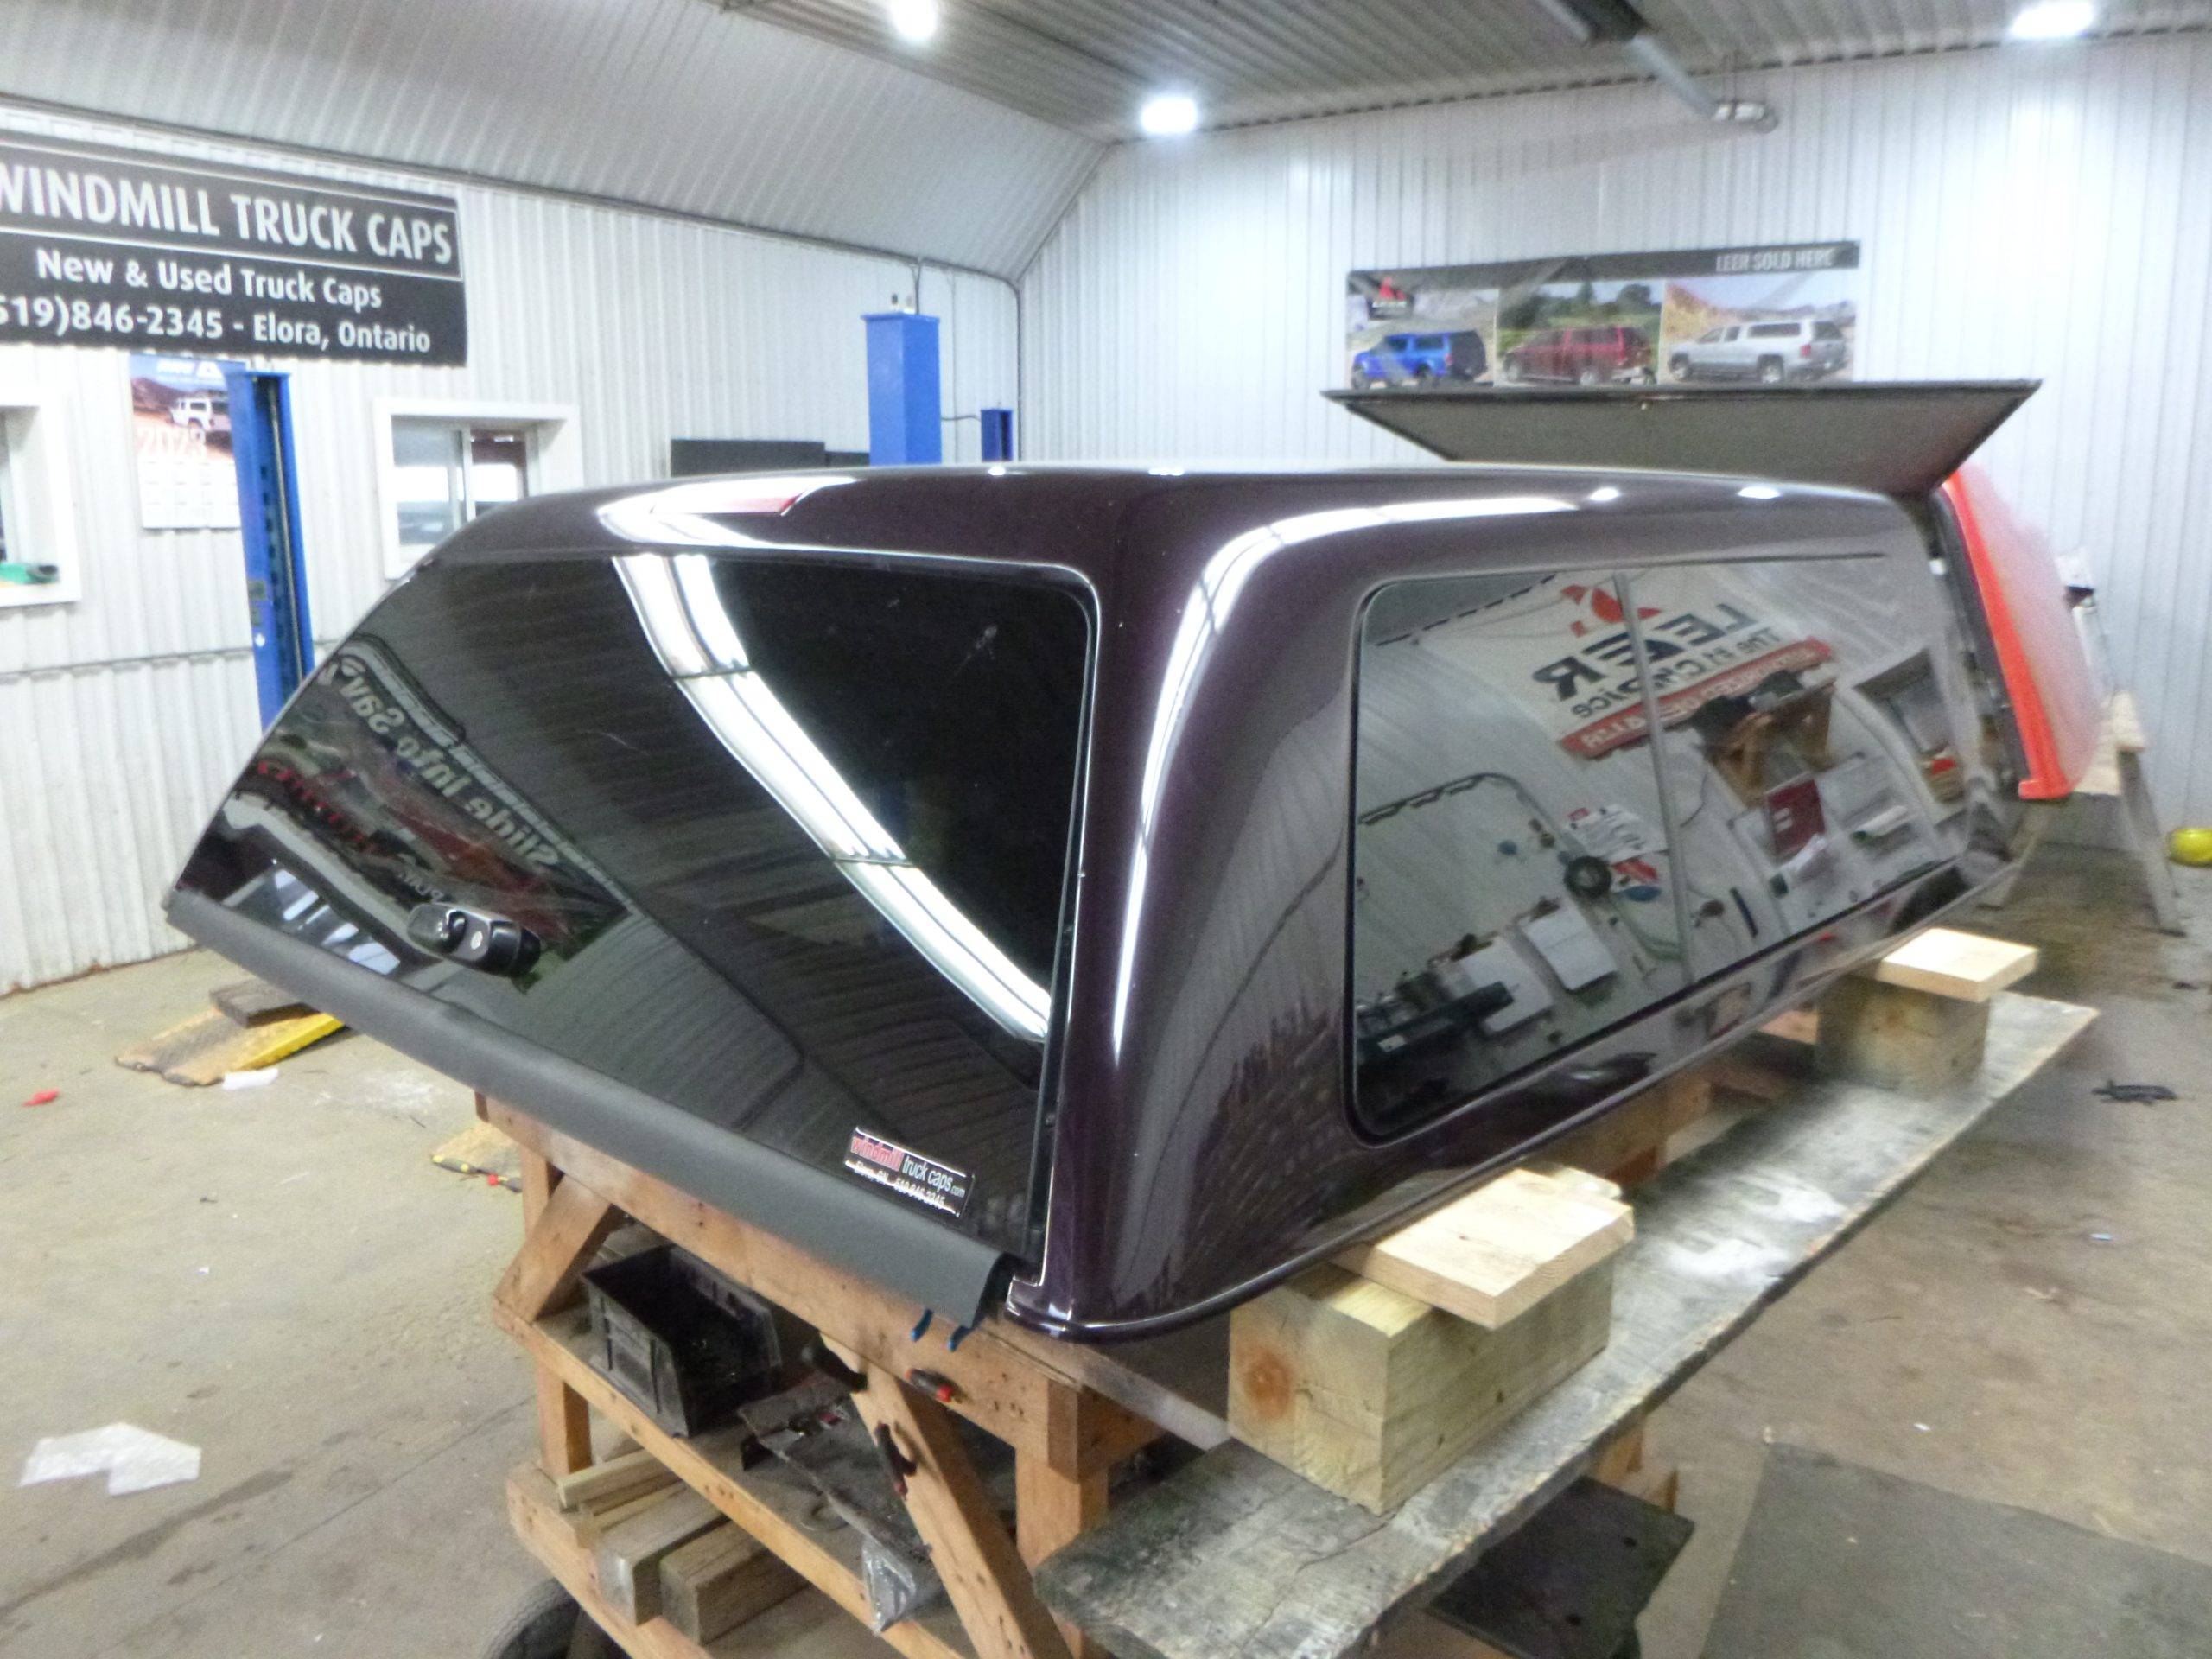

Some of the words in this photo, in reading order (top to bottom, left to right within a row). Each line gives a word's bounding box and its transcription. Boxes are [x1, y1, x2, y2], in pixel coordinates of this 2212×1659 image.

[0, 162, 219, 236] WINDMILL
[231, 193, 357, 252] TRUCK
[367, 213, 452, 264] CAPS
[1753, 251, 1792, 270] SOLD
[1796, 248, 1835, 268] HERE
[37, 249, 113, 283] New
[126, 261, 148, 288] &
[158, 261, 231, 295] Used
[241, 269, 315, 302] Truck
[324, 278, 382, 313] Caps
[253, 315, 329, 350] Elora,
[338, 323, 430, 353] Ontario
[902, 1156, 927, 1182] truck
